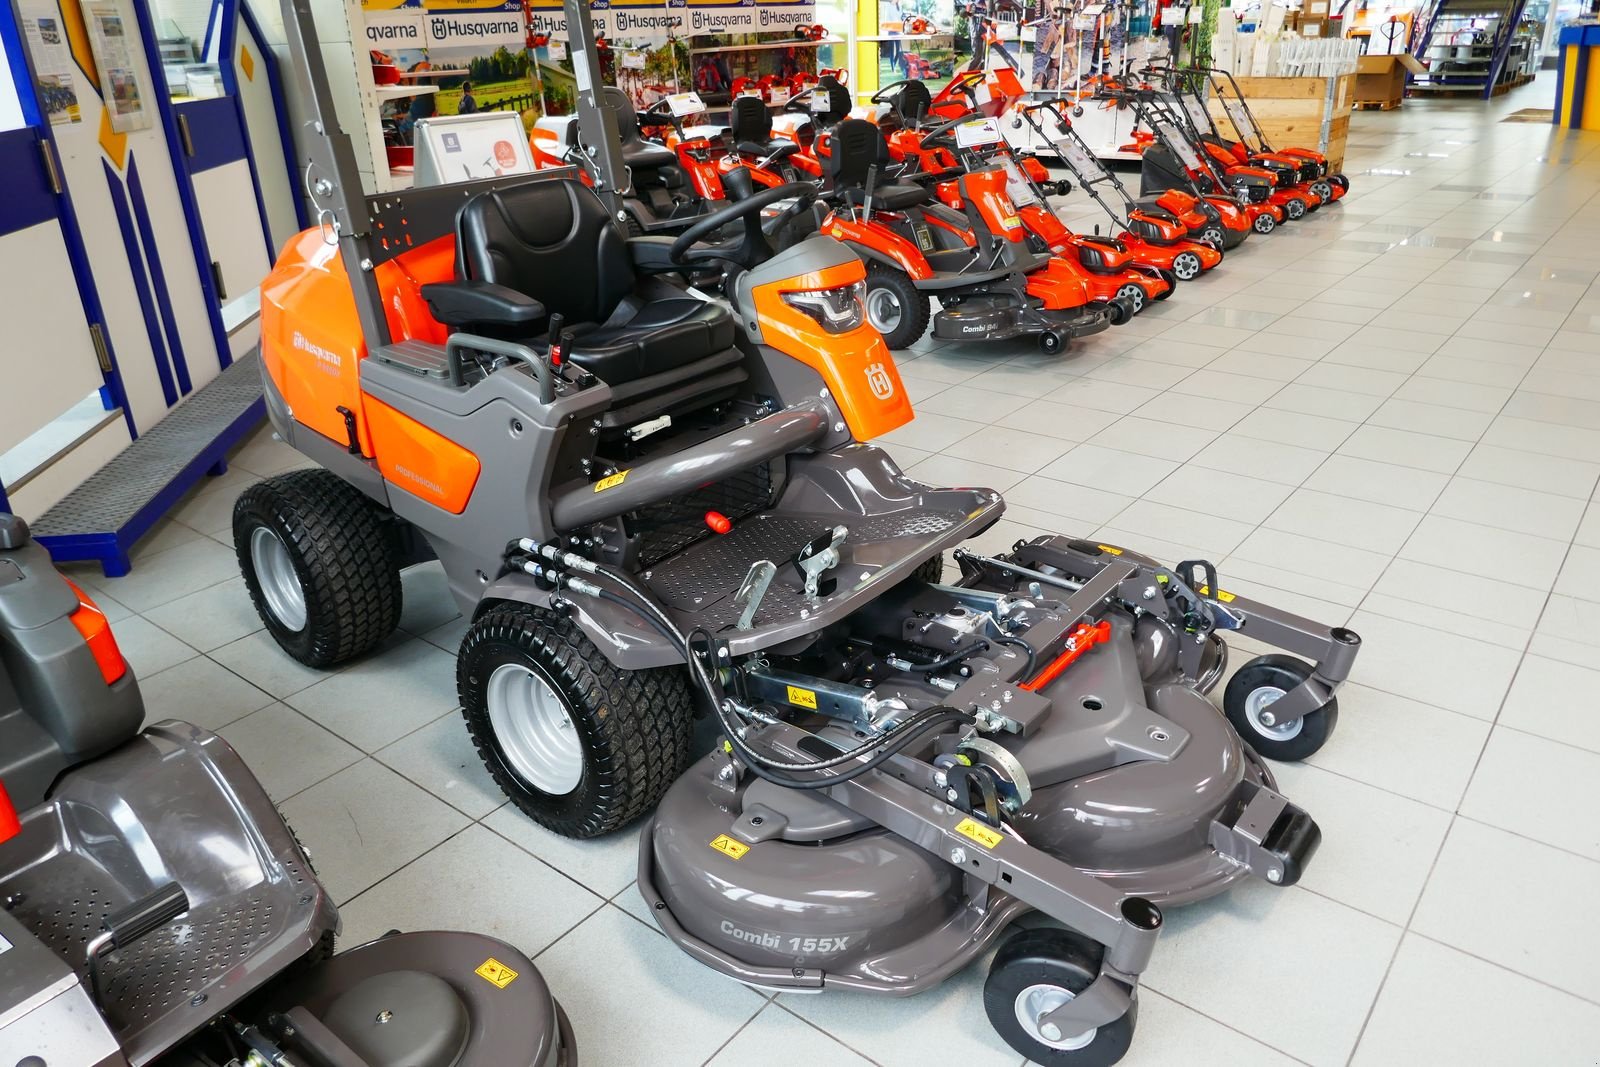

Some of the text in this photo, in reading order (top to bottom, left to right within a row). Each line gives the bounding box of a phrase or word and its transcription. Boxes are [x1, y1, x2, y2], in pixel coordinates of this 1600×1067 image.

[504, 3, 521, 11] Shop
[593, 0, 608, 8] Shop
[702, 13, 752, 27] Husqvarna
[769, 11, 812, 25] Husqvarna
[366, 24, 417, 41] qvarna
[447, 20, 519, 37] Husqvarna
[963, 324, 986, 333] Combi
[720, 920, 849, 952] Combi 155X
